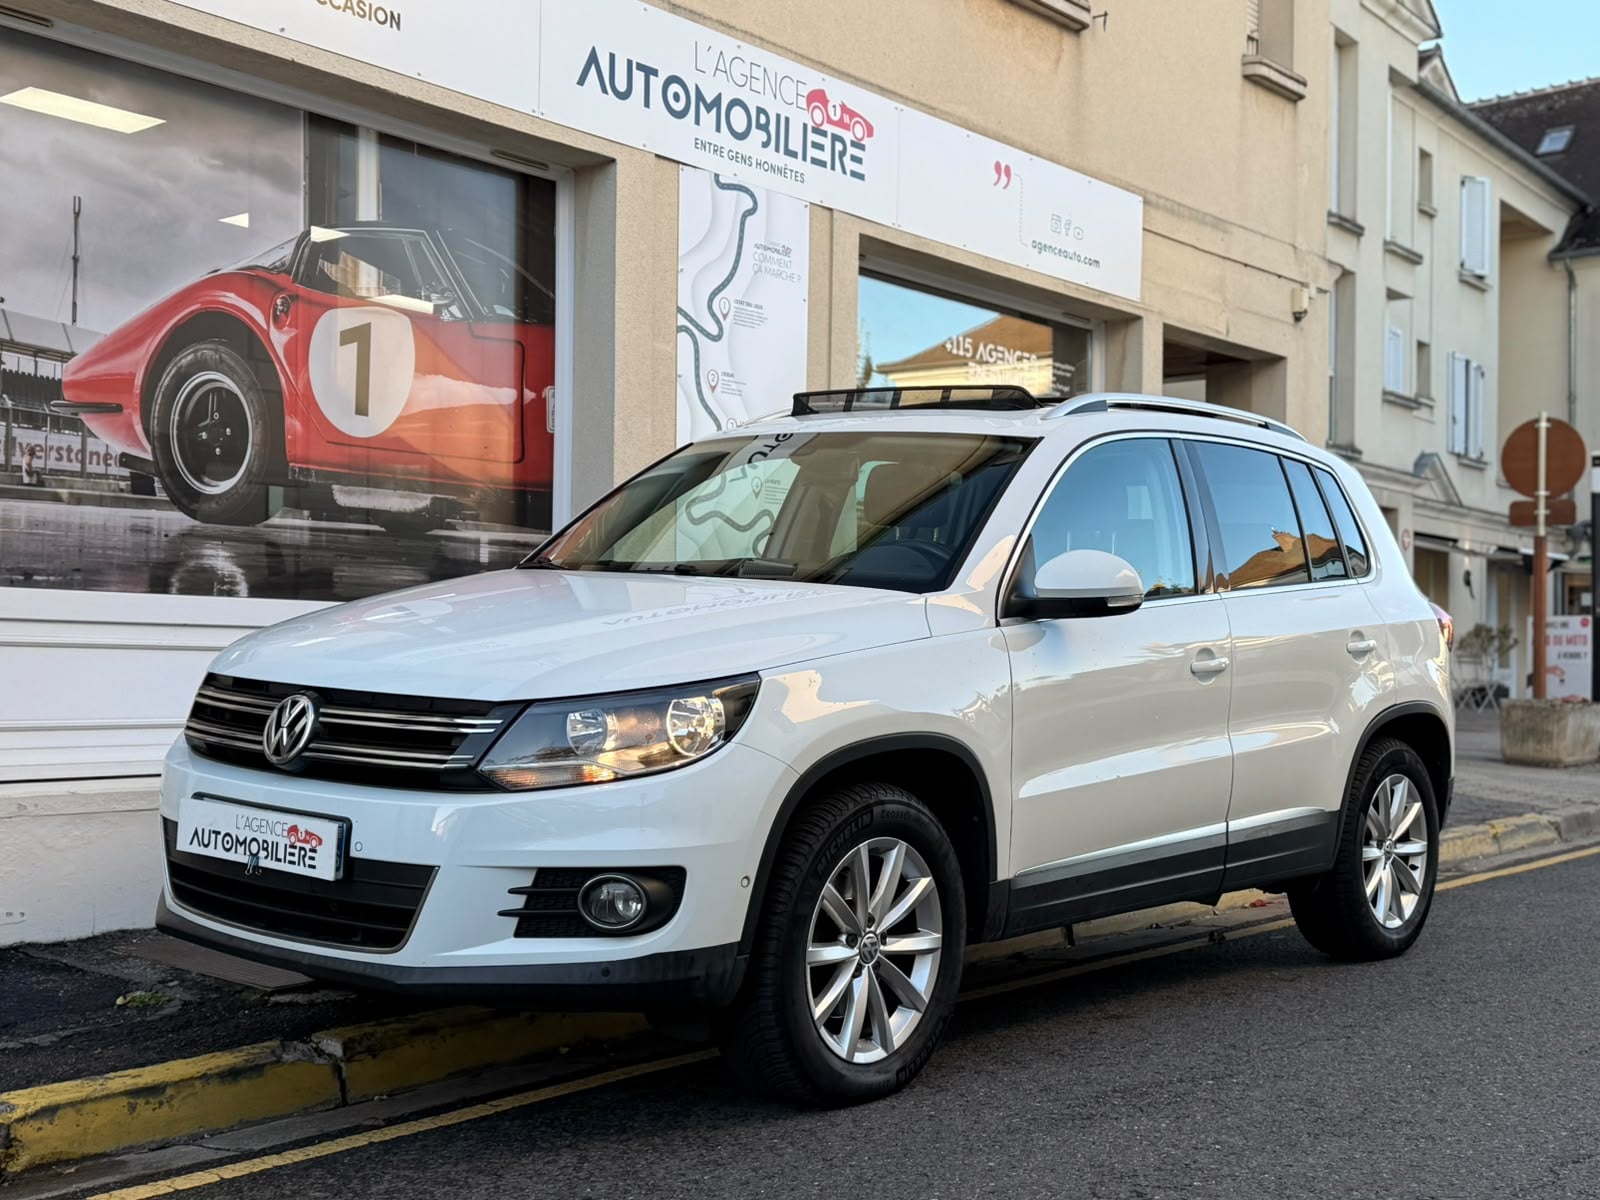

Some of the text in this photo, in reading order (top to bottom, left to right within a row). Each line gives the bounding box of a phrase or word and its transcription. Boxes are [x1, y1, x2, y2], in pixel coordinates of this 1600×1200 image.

[695, 40, 807, 111] L'AGENCE
[576, 45, 866, 182] AUTOMOBILIERE
[694, 138, 805, 183] ENTRE GENS HONNÊTES
[753, 251, 792, 270] COMMENT
[1031, 239, 1100, 269] agenceauto.com
[339, 322, 371, 417] 1
[235, 813, 289, 838] L'AGENCE
[189, 826, 318, 870] AUTOMOBILIERE
